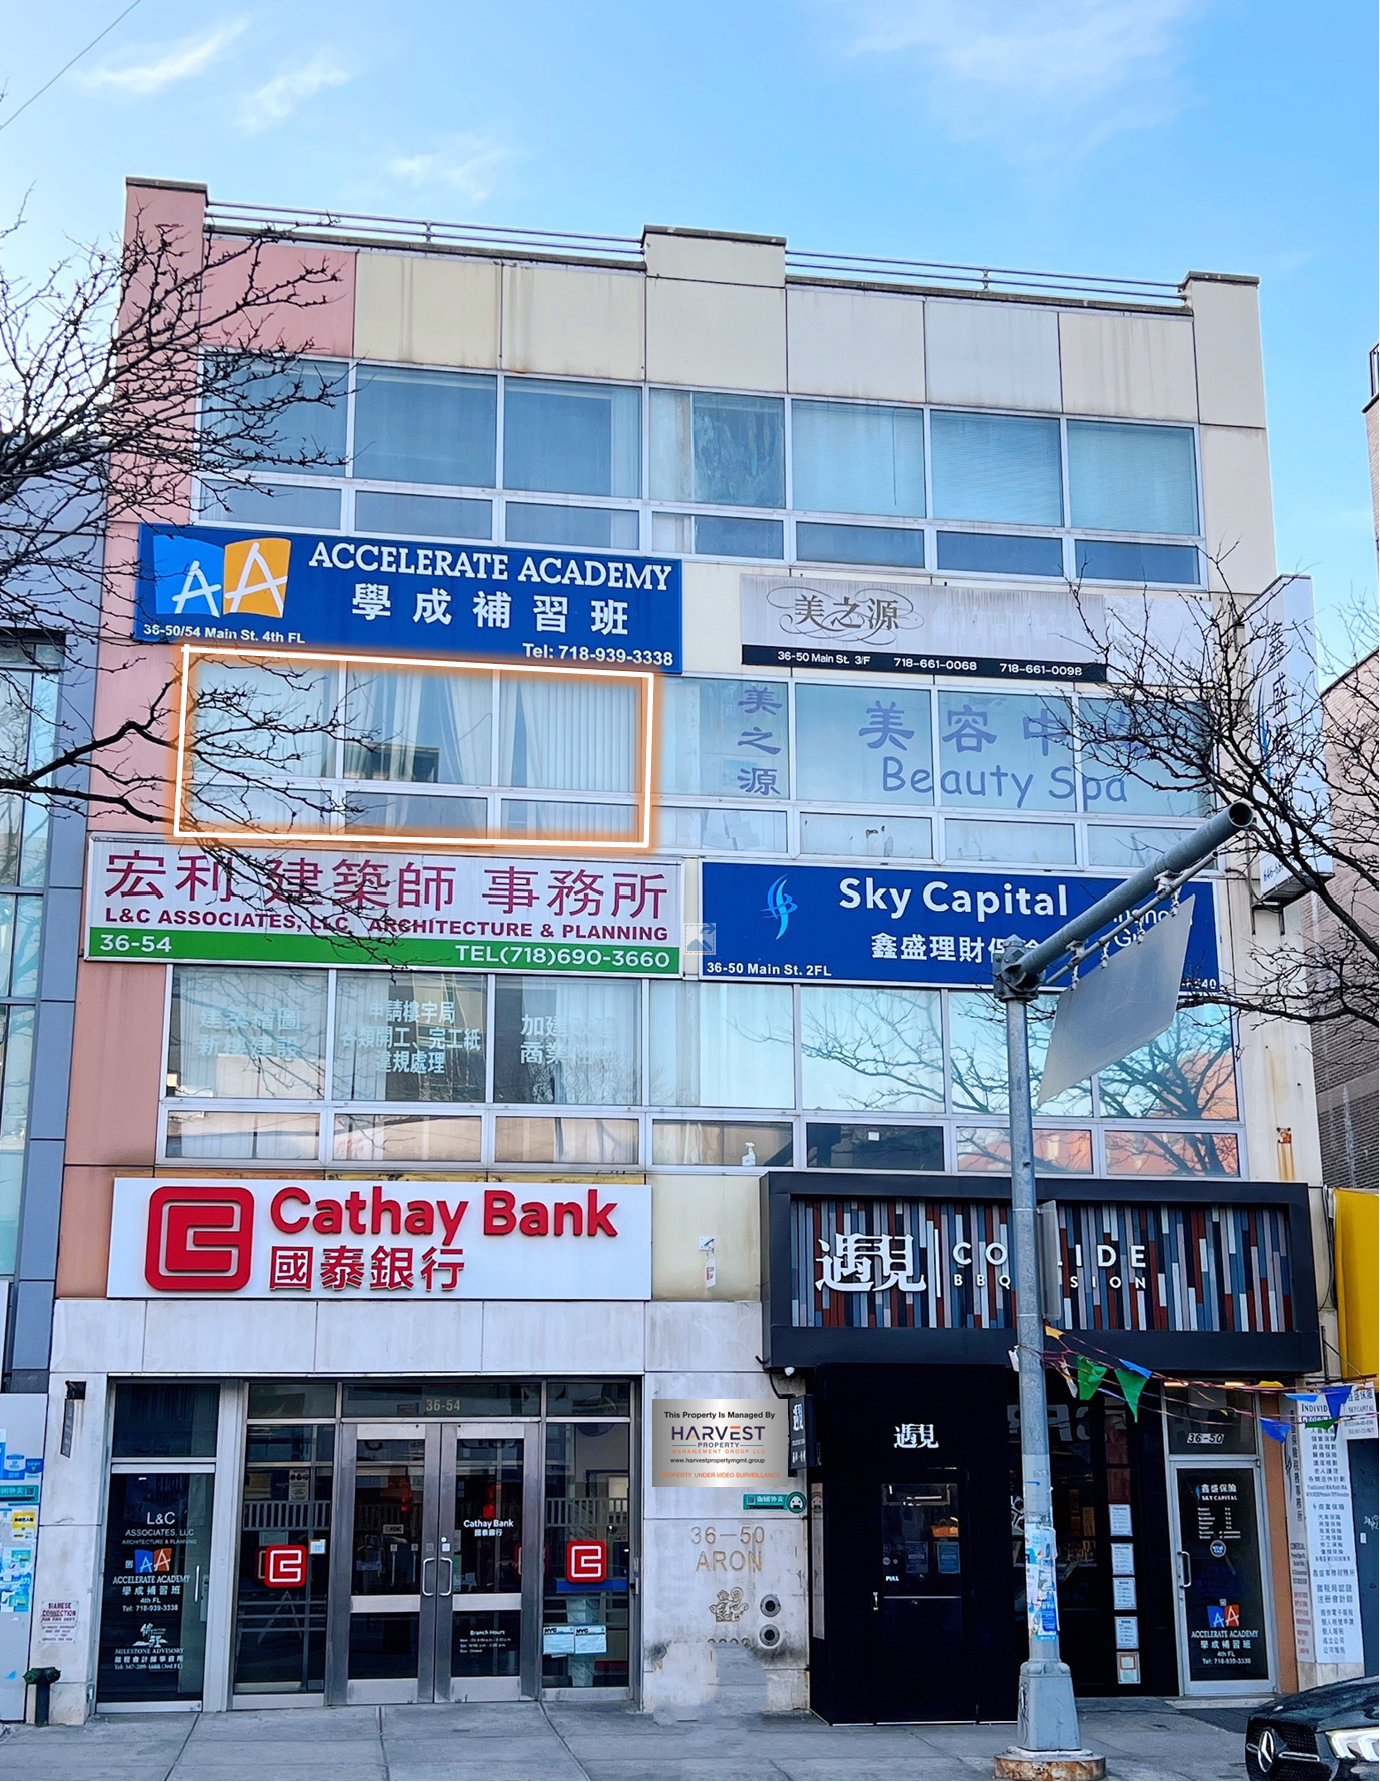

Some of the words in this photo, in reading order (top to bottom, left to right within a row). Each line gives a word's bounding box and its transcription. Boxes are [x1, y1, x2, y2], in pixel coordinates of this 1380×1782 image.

[309, 541, 508, 581] ACCELERATE
[517, 556, 672, 591] ACADEMY
[352, 582, 628, 636] 學成補習班
[794, 593, 899, 631] 美之源
[204, 626, 237, 640] Main
[240, 629, 259, 642] St.
[262, 630, 284, 643] 4th
[288, 632, 306, 644] FL
[522, 643, 554, 659] Tel:
[558, 645, 674, 666] 718-939-3338
[777, 651, 810, 662] 36-50
[811, 653, 834, 664] Main
[835, 655, 850, 665] St.
[854, 656, 870, 666] 3/F
[893, 657, 978, 671] 718-661-0068
[999, 663, 1083, 676] 718-661-0098
[737, 685, 783, 796] 美之源
[882, 755, 1034, 809] Beauty
[1048, 765, 1128, 812] Spa
[105, 850, 233, 903] 宏利
[263, 857, 456, 912] 建築師
[481, 865, 668, 920] 事務所
[839, 877, 912, 919] Sky
[923, 880, 1068, 923] Capital
[105, 907, 151, 924] L&C
[157, 909, 302, 933] ASSOCIATES,
[368, 918, 533, 938] ARCHITECTURE
[540, 924, 555, 938] &
[562, 925, 669, 941] PLANNING
[100, 934, 172, 953] 36-54
[871, 932, 1041, 964] 鑫盛理財
[455, 944, 671, 968] TEL(718)690-3660
[706, 962, 745, 975] 36-50
[748, 963, 781, 976] Main
[784, 964, 803, 977] St.
[806, 965, 832, 978] 2FL
[270, 1186, 469, 1246] Cathay
[483, 1189, 618, 1238] Bank
[815, 1233, 927, 1292] 遇見
[953, 1241, 1147, 1268] COIDE
[269, 1245, 466, 1292] 國泰銀行
[953, 1274, 1011, 1290] BBQ
[425, 1398, 461, 1412] 36-54
[664, 1411, 681, 1419] This
[682, 1411, 717, 1420] Property
[718, 1411, 726, 1419] Is
[727, 1411, 764, 1420] Managed
[765, 1411, 776, 1420] By
[671, 1425, 766, 1441] HARVEST
[893, 1423, 940, 1449] 遇見
[1188, 1433, 1223, 1443] 36-50
[146, 1511, 176, 1525] L&C
[463, 1519, 493, 1529] Cathay
[493, 1518, 514, 1528] Bank
[179, 1529, 195, 1537] LLC
[695, 1549, 763, 1572] ARON
[113, 1575, 155, 1584] ACCELERATE
[156, 1574, 191, 1584] ACADEMY
[1191, 1630, 1228, 1639] ACCELERATE
[1229, 1630, 1259, 1638] ACADEMY
